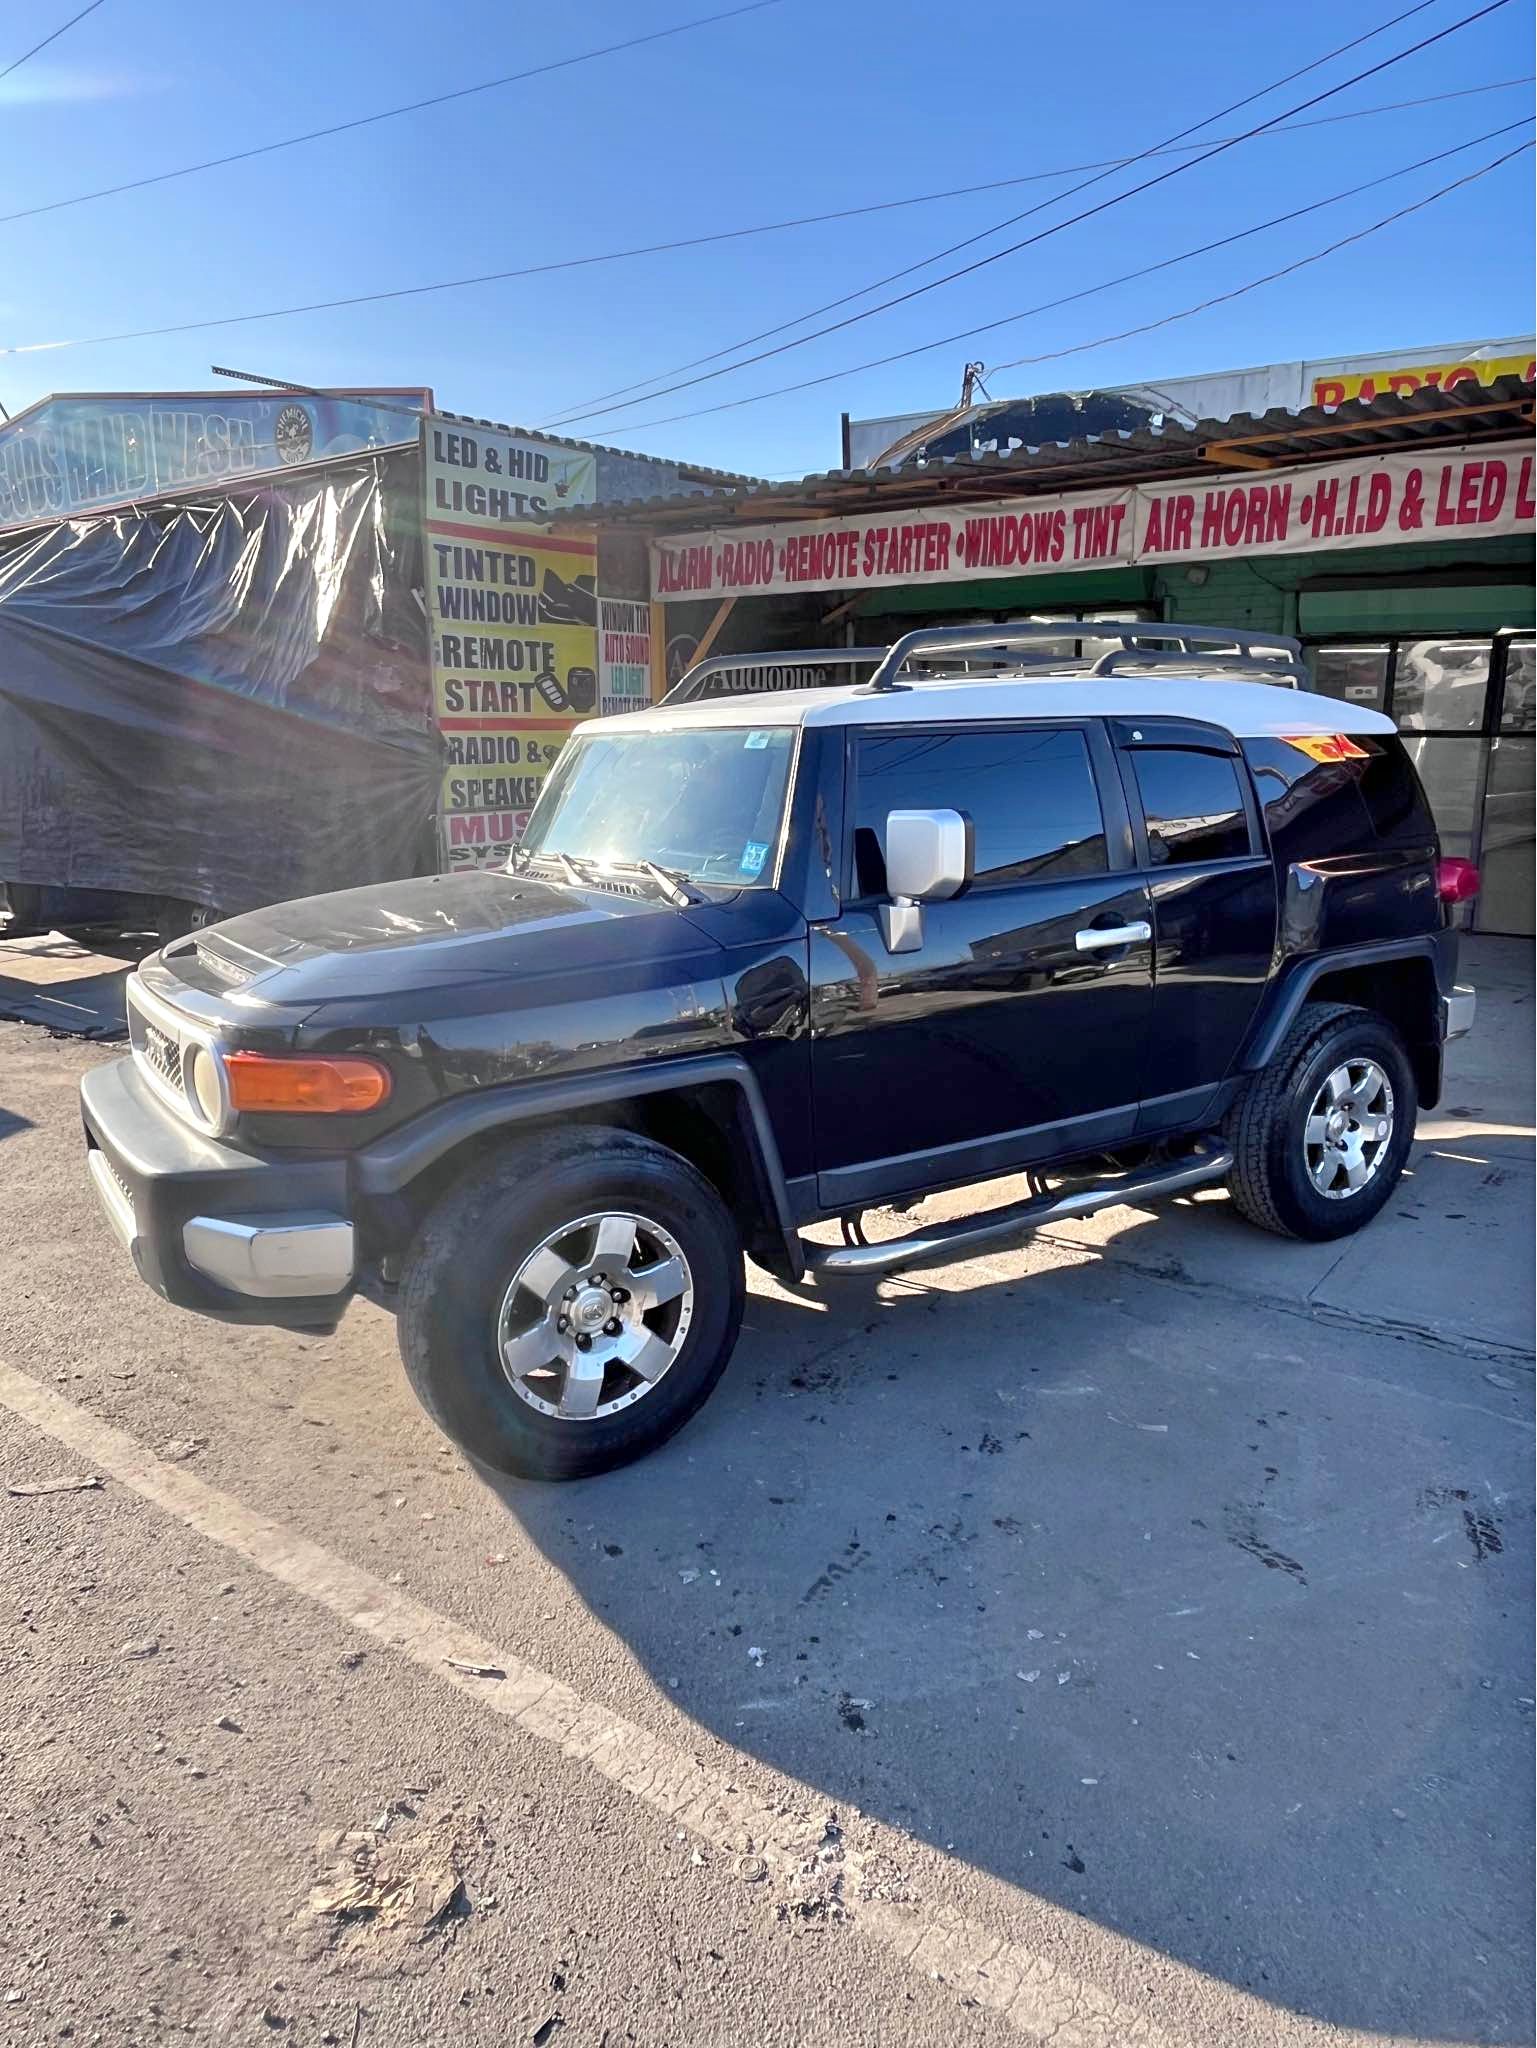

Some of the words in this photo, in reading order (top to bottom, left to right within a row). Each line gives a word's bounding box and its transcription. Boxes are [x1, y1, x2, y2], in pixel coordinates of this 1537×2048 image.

[151, 411, 255, 488] WASH
[433, 431, 477, 469] LED
[485, 448, 502, 475] &
[509, 448, 549, 483] HID
[435, 478, 548, 520] LIGHTS
[1143, 495, 1195, 553] AIR
[1200, 483, 1292, 548] HORN
[1312, 472, 1391, 538] H.I.D
[1400, 468, 1423, 531] &
[1436, 457, 1507, 526] LED
[433, 544, 536, 588] TINTED
[658, 546, 712, 592] ALARM
[722, 538, 774, 587] RADIO
[785, 531, 860, 582] REMOTE
[863, 522, 951, 577] STARTER
[964, 510, 1066, 569] WINDOWS
[1073, 504, 1126, 560] TINT
[438, 585, 538, 626] WINDOW
[442, 635, 555, 673] REMOTE
[444, 679, 535, 713] START
[447, 736, 520, 765] RADIO
[527, 741, 541, 763] &
